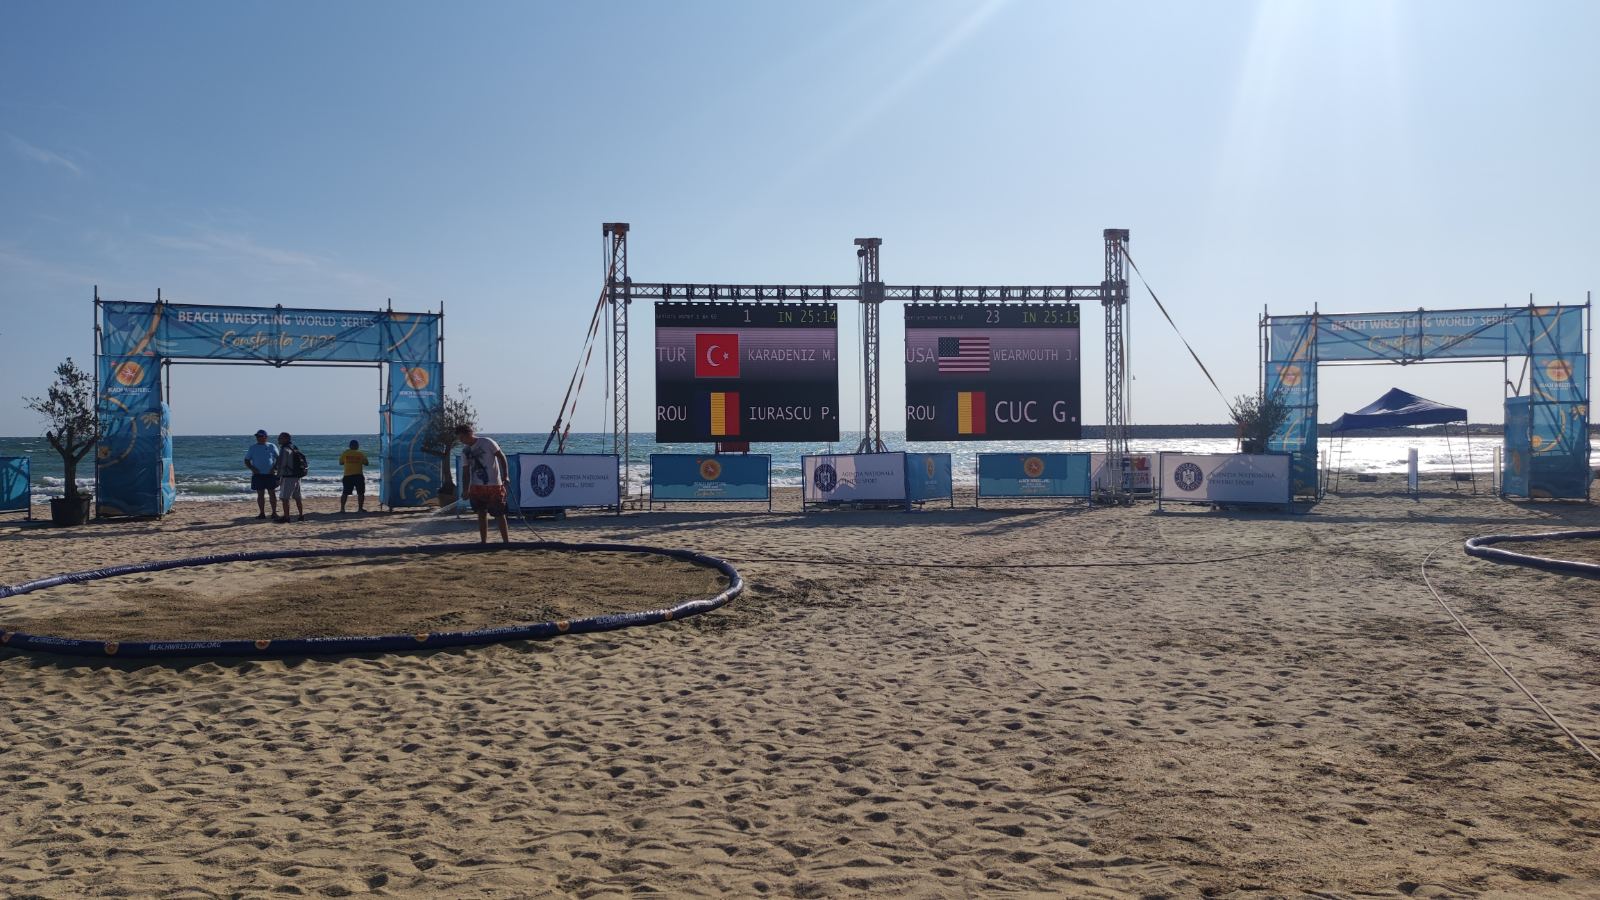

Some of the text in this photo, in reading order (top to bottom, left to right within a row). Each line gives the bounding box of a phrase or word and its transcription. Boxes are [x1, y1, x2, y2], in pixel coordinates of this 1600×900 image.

[178, 311, 376, 328] BEACH WRESTLING WORLD SERIES
[744, 309, 837, 322] 1 IN 25:14
[986, 310, 1080, 323] 23 IN 25:15
[1331, 314, 1515, 331] BEACH WRESTLING WORLD SERIES
[656, 346, 836, 362] TUR KARADENIZ M.
[906, 347, 1078, 363] USA WEARMOUTH J.
[657, 405, 836, 421] ROU IURASCU P.
[907, 400, 1077, 423] ROU CUC G.
[149, 642, 221, 650] BEACHWRESTLING.ORG
